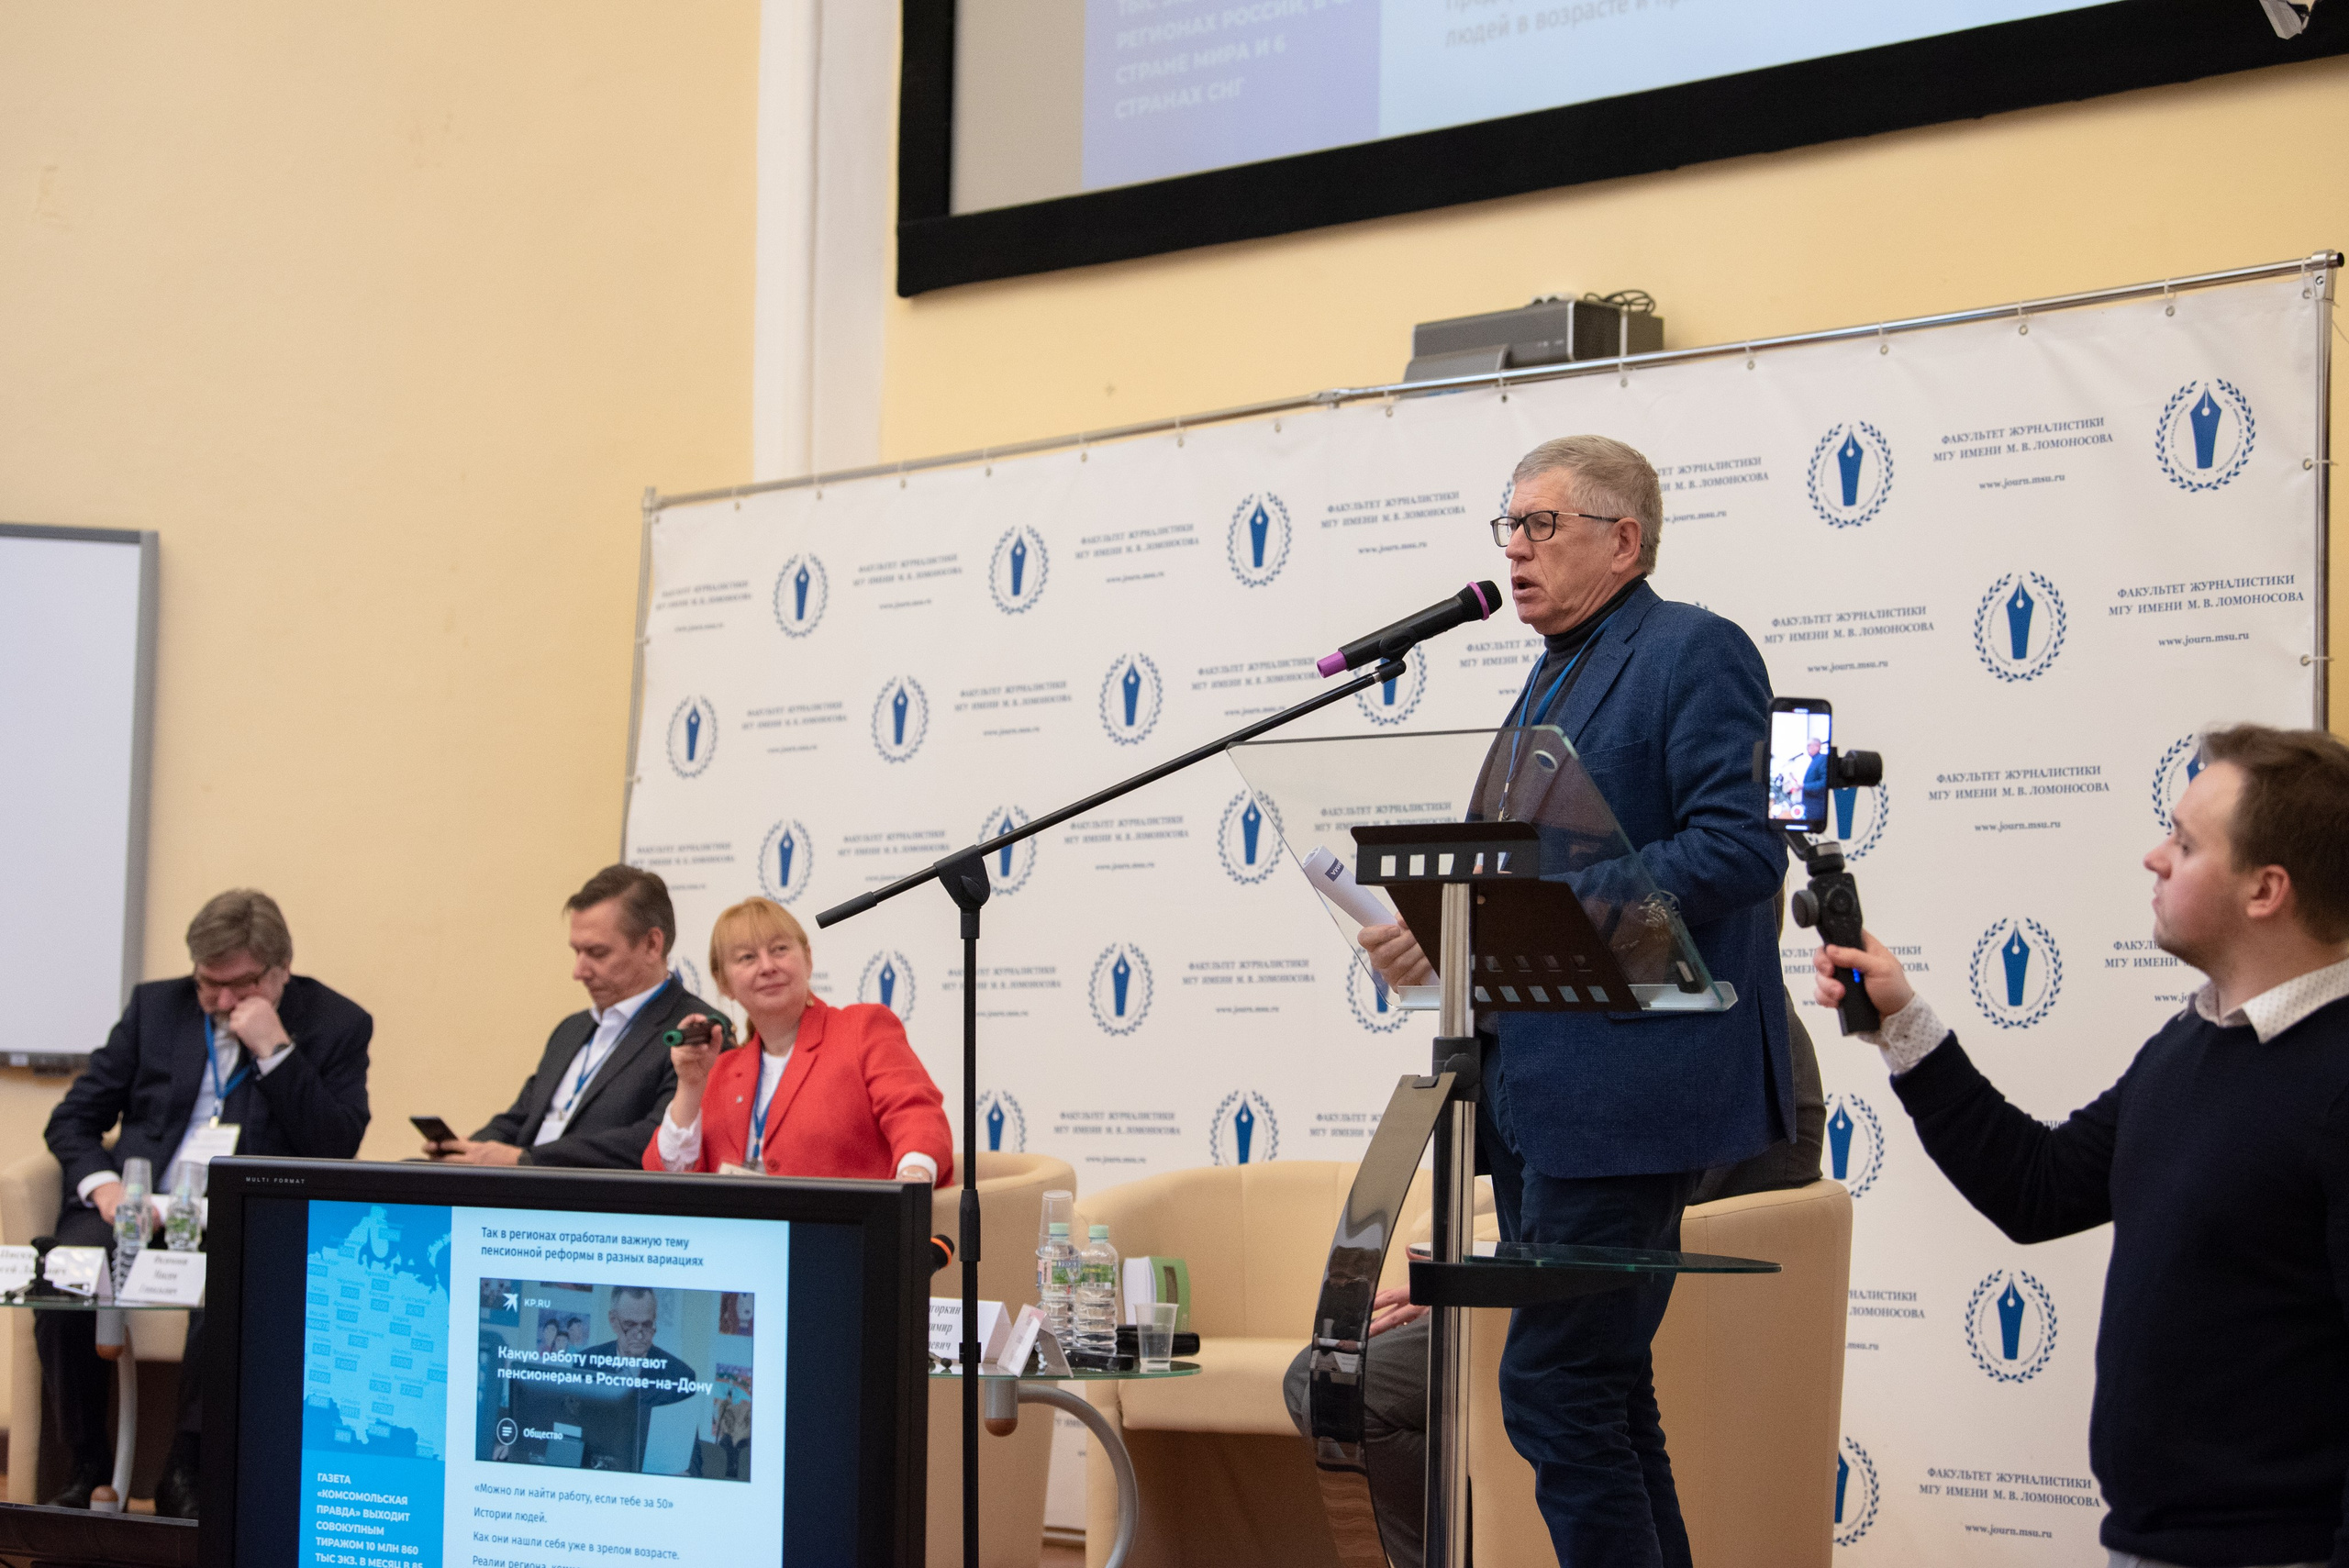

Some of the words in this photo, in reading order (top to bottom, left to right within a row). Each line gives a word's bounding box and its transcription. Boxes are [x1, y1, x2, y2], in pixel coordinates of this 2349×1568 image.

[1117, 14, 1216, 50] РЕГИОНАХ
[1445, 12, 1509, 48] людей
[1517, 16, 1530, 34] в
[1535, 0, 1628, 28] возрасте
[1116, 54, 1187, 84] СТРАНЕ
[1194, 41, 1249, 68] МИРА
[1254, 37, 1270, 56] И
[1274, 33, 1286, 53] 6
[1116, 86, 1203, 119] СТРАНАХ
[1208, 77, 1245, 102] СНГ
[1941, 428, 2004, 444] ФАКУЛЬТЕТ
[2009, 417, 2103, 436] ЖУРНАЛИСТИКИ
[1933, 450, 1954, 461] МГУ
[1960, 445, 2000, 458] ИМЕНИ
[2007, 443, 2018, 452] М.
[2021, 442, 2031, 450] В.
[2033, 433, 2112, 450] ЛОМОНОСОВА
[1677, 456, 1761, 473] ЖУРНАЛИСТИКИ
[1699, 472, 1768, 487] ЛОМОНОСОВА
[1978, 474, 2065, 488] www.journ.msu.ru
[1327, 500, 1380, 513] ФАКУЛЬТЕТ
[1385, 491, 1459, 506] ЖУРНАЛИСТИКИ
[1320, 518, 1337, 528] МГУ
[1342, 515, 1377, 526] ИМЕНИ
[1393, 512, 1399, 520] В.
[1402, 506, 1465, 519] ЛОМОНОСОВА
[1664, 510, 1727, 524] w.journ.msu.ru
[1358, 541, 1427, 553] www.journ.msu.ru
[2117, 584, 2185, 597] ФАКУЛЬТЕТ
[2190, 574, 2294, 591] ЖУРНАЛИСТИКИ
[2109, 606, 2132, 615] МГУ
[2138, 601, 2181, 613] ИМЕНИ
[2188, 599, 2199, 608] М.
[2203, 598, 2212, 607] В.
[2215, 592, 2303, 606] ЛОМОНОСОВА
[1771, 614, 1831, 627] ФАКУЛЬТЕТ
[1836, 606, 1925, 621] ЖУРНАЛИСТИКИ
[1765, 634, 1784, 643] МГУ
[1789, 630, 1828, 641] ИМЕНИ
[1833, 628, 1844, 638] М.
[1847, 628, 1856, 637] В.
[1859, 622, 1933, 636] ЛОМОНОСОВА
[2158, 632, 2249, 646] www.journ.msu.ru
[1466, 639, 1520, 651] ФАКУЛЬТЕТ
[1807, 661, 1887, 673] www.journ.msu.ru
[1936, 771, 1999, 783] ФАКУЛЬТЕТ
[2005, 765, 2100, 779] ЖУРНАЛИСТИКИ
[1929, 790, 1950, 799] МГУ
[1955, 787, 1996, 798] ИМЕНИ
[2002, 787, 2014, 795] М.
[2017, 786, 2026, 795] В.
[2029, 782, 2109, 795] ЛОМОНОСОВА
[1320, 806, 1371, 816] ФАКУЛЬТЕТ
[1375, 802, 1451, 813] ЖУРНАЛИСТИКИ
[1975, 821, 2060, 832] www.journ.msu.ru
[1782, 948, 1814, 957] КУЛЬТ
[2113, 940, 2160, 950] ФАКУЛЬ
[1785, 962, 1816, 973] ИМЕН
[2105, 958, 2127, 967] МГУ
[2133, 954, 2178, 966] ИМЕНИ
[481, 1227, 497, 1237] Так
[501, 1229, 506, 1238] в
[509, 1230, 555, 1240] регионах
[559, 1231, 618, 1243] отработали
[621, 1236, 662, 1248] важную
[665, 1238, 688, 1250] тему
[481, 1246, 541, 1257] пенсионной
[545, 1248, 594, 1262] реформы
[597, 1252, 603, 1261] в
[606, 1252, 643, 1263] разных
[647, 1255, 702, 1266] вариациях
[524, 1298, 550, 1307] KP.RU
[1849, 1289, 1916, 1301] НАЛИСТИКИ
[1849, 1307, 1924, 1318] ЛОМОНОСОВА
[498, 1346, 539, 1362] Какую
[542, 1350, 586, 1366] работу
[589, 1354, 667, 1368] предлагают
[497, 1368, 581, 1385] пенсионерам
[585, 1374, 592, 1384] в
[596, 1372, 712, 1395] Ростове-на-Дону
[523, 1428, 563, 1440] Общество
[317, 1473, 351, 1484] ГАЗЕТА
[1927, 1467, 1991, 1481] ФАКУЛЬТЕТ
[1996, 1473, 2090, 1488] ЖУРНАЛИСТИКИ
[317, 1489, 407, 1505] «КОМСОМОЛЬСКАЯ
[474, 1483, 511, 1495] «Можно
[514, 1487, 525, 1496] ли
[529, 1489, 555, 1498] найти
[558, 1490, 592, 1504] работу,
[595, 1495, 616, 1503] если
[619, 1496, 640, 1506] тебе
[643, 1498, 653, 1507] за
[657, 1498, 673, 1508] 50»
[1919, 1484, 1940, 1494] МГУ
[1946, 1486, 1987, 1497] ИМЕНИ
[1993, 1489, 2005, 1499] М.
[2009, 1490, 2018, 1500] В.
[2021, 1492, 2100, 1507] ЛОМОНОСОВА
[317, 1505, 361, 1517] ПРАВДА»
[363, 1509, 410, 1521] ВЫХОДИТ
[473, 1507, 511, 1520] Истории
[515, 1512, 546, 1522] людей.
[316, 1521, 384, 1535] СОВОКУПНЫМ
[1965, 1524, 2052, 1538] www.journ.msu.ru
[316, 1537, 363, 1550] ТИРАЖОМ
[366, 1541, 375, 1551] 10
[377, 1542, 399, 1552] МЛН
[401, 1545, 418, 1555] 860
[473, 1531, 488, 1541] Как
[491, 1534, 508, 1542] они
[511, 1537, 541, 1546] нашли
[544, 1538, 564, 1548] себя
[568, 1542, 585, 1551] уже
[588, 1543, 594, 1551] в
[596, 1544, 631, 1554] зрелом
[634, 1548, 678, 1559] возрасте.
[315, 1552, 335, 1562] ТЫС
[337, 1554, 358, 1565] ЭКЗ.
[360, 1557, 366, 1566] В
[368, 1558, 401, 1568] МЕСЯЦ
[473, 1555, 506, 1567] Реалии
